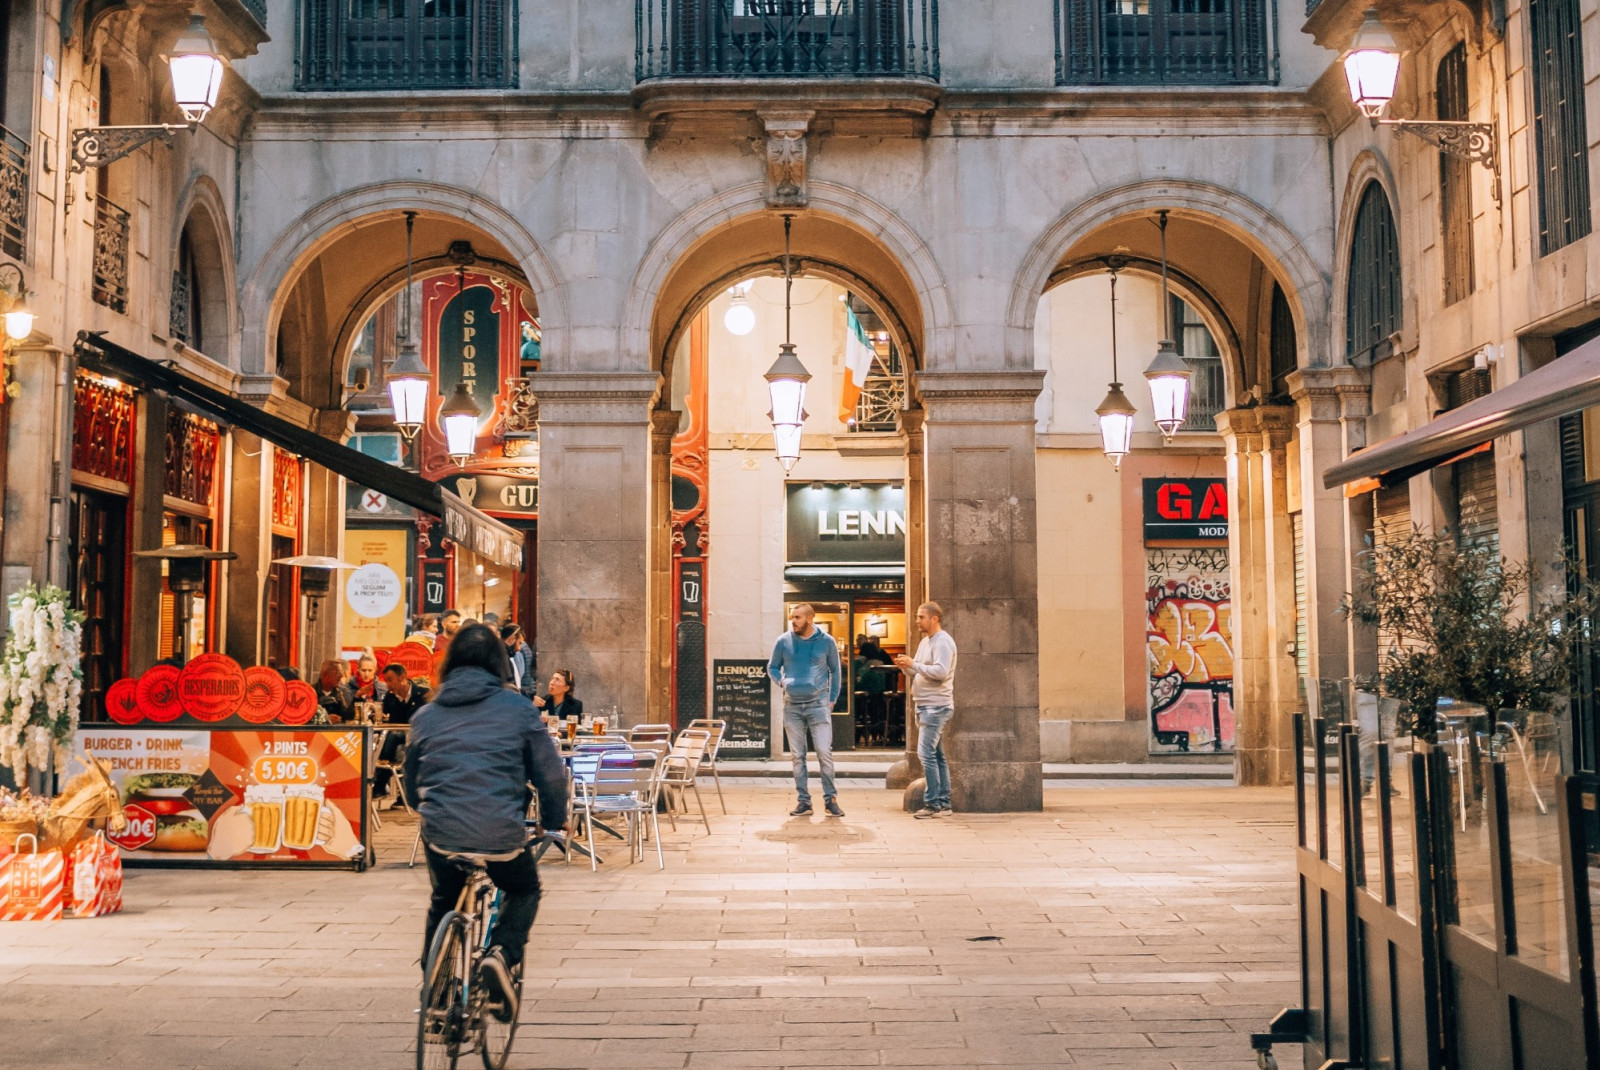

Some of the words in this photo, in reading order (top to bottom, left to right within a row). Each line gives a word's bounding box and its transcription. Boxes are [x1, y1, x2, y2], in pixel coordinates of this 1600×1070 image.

[500, 485, 539, 507] GU
[1157, 483, 1228, 519] GA
[818, 510, 905, 535] LENN
[717, 666, 763, 675] LENNOX
[184, 679, 240, 696] DESPERADOS
[84, 738, 132, 750] BURGER
[146, 738, 183, 750] DRINK
[264, 741, 271, 755] 2
[274, 741, 308, 755] PINTS
[147, 757, 181, 770] FRIES
[262, 761, 309, 782] 5,90€
